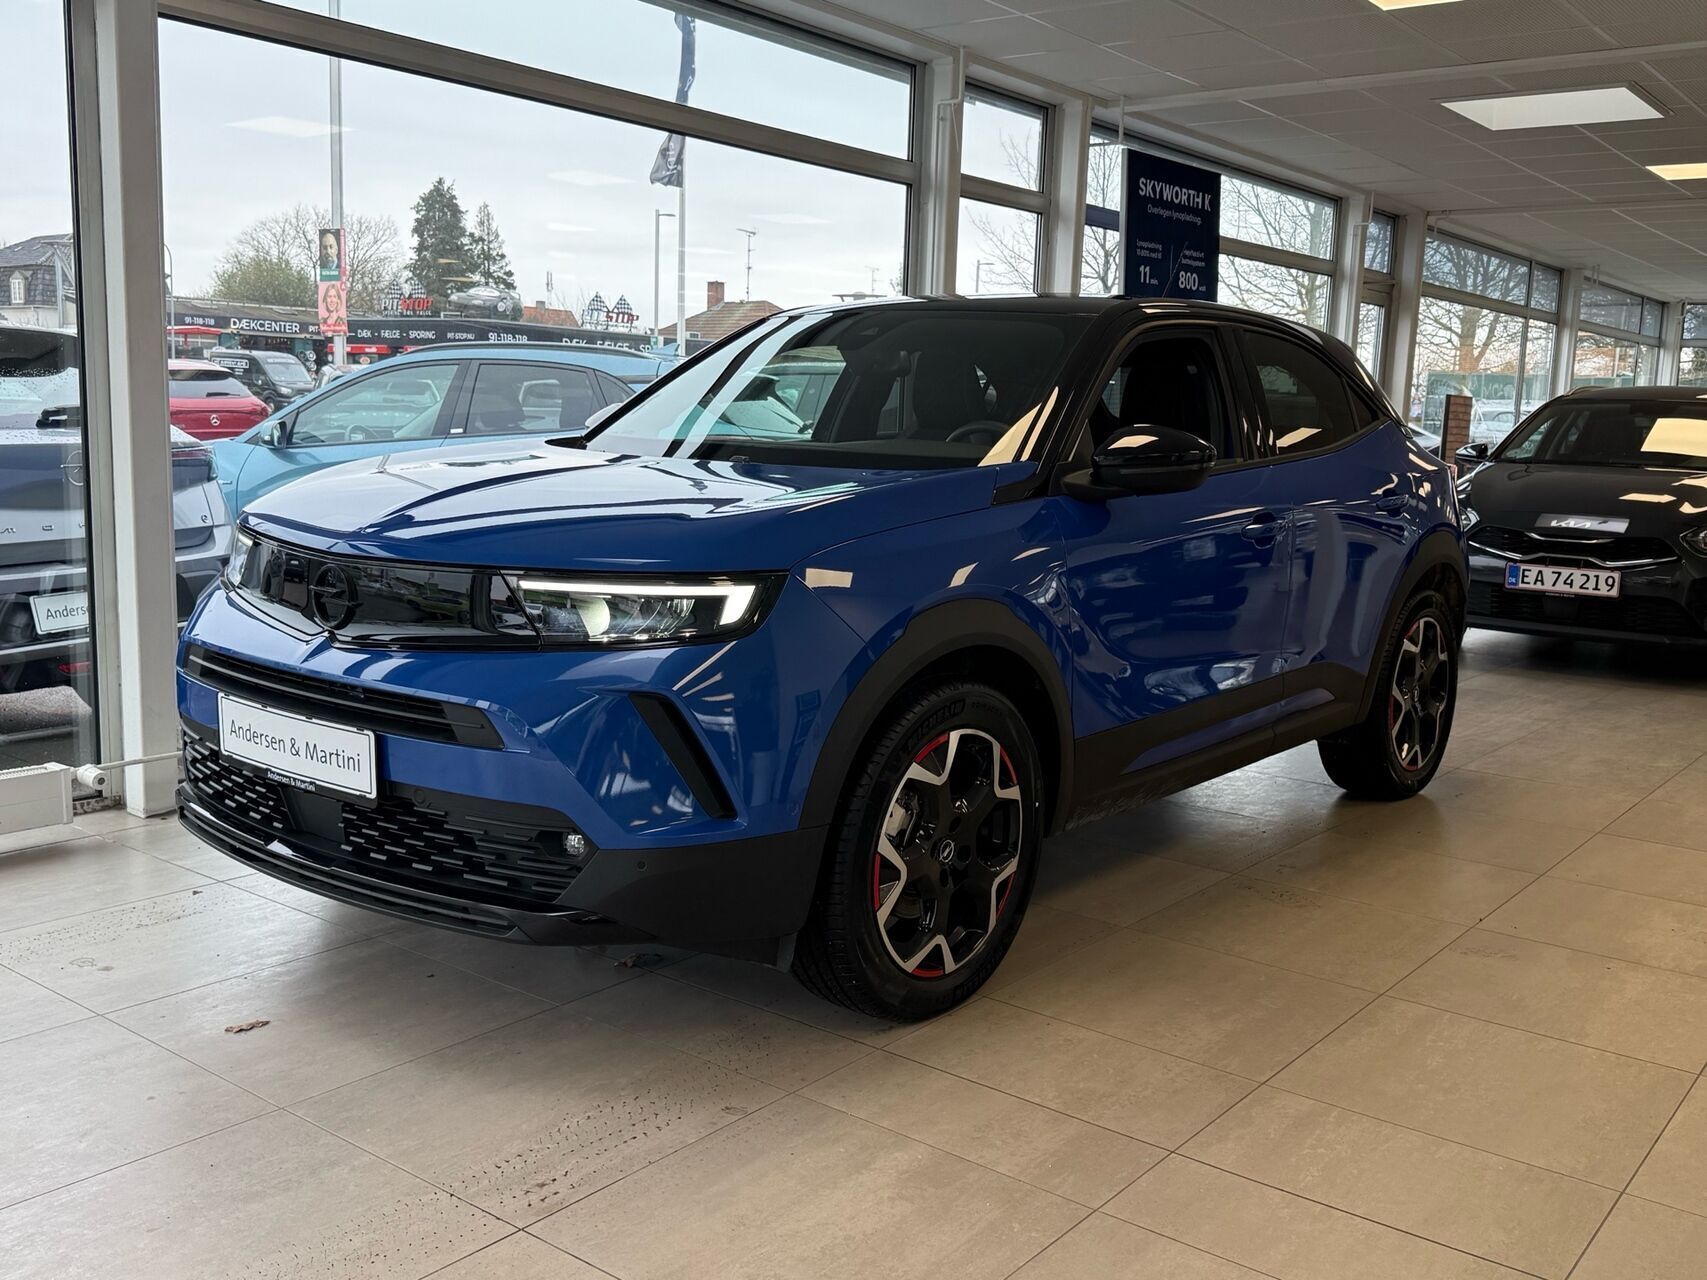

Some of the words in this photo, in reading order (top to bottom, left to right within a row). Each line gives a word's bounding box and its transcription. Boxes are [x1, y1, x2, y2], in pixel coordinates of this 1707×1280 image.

[1139, 177, 1202, 209] SKYWORTH
[1204, 193, 1212, 212] K
[1139, 264, 1150, 284] 11
[1178, 270, 1199, 291] 800
[184, 316, 215, 326] 91-118-118
[230, 318, 300, 333] DÆKCENTER
[357, 329, 372, 338] DÆK
[381, 329, 400, 339] FÆLGE
[408, 330, 436, 340] SPORING
[1520, 568, 1545, 587] EA
[1551, 571, 1574, 589] 74
[1579, 573, 1616, 593] 219
[229, 719, 286, 754] Andersen
[290, 737, 301, 757] &
[305, 741, 361, 773] Martini
[267, 770, 290, 785] Andersen
[296, 779, 316, 792] Martini
